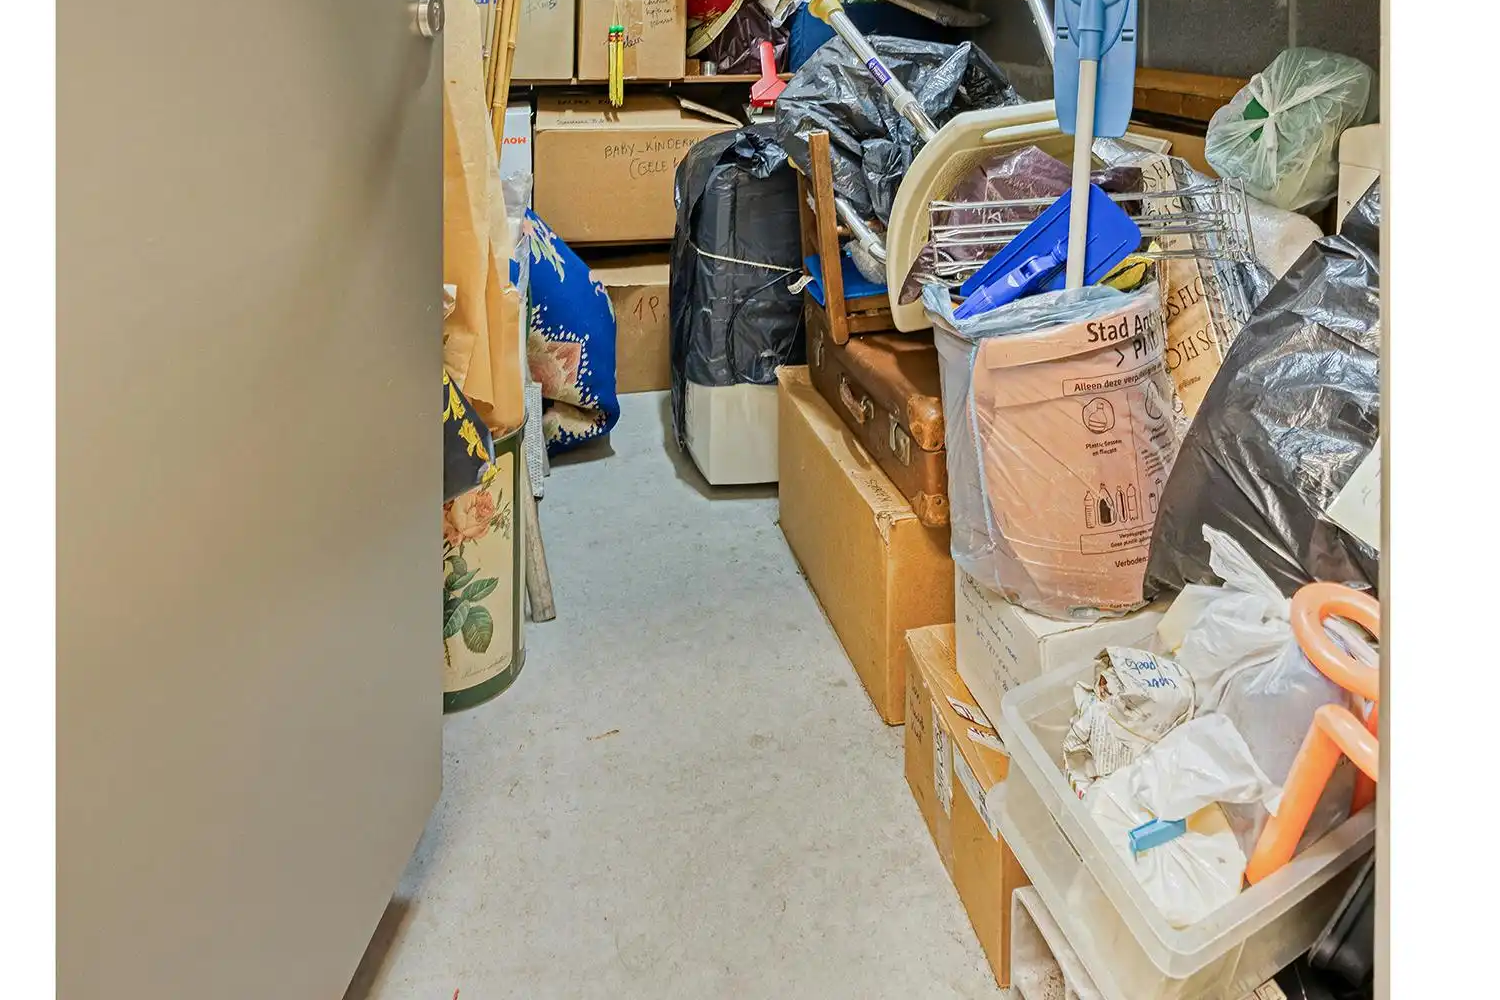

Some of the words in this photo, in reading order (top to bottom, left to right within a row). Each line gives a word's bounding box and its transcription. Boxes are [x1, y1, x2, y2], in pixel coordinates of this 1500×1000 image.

[1086, 316, 1129, 343] Stad
[1074, 381, 1102, 393] Alleen
[1104, 378, 1122, 389] deze
